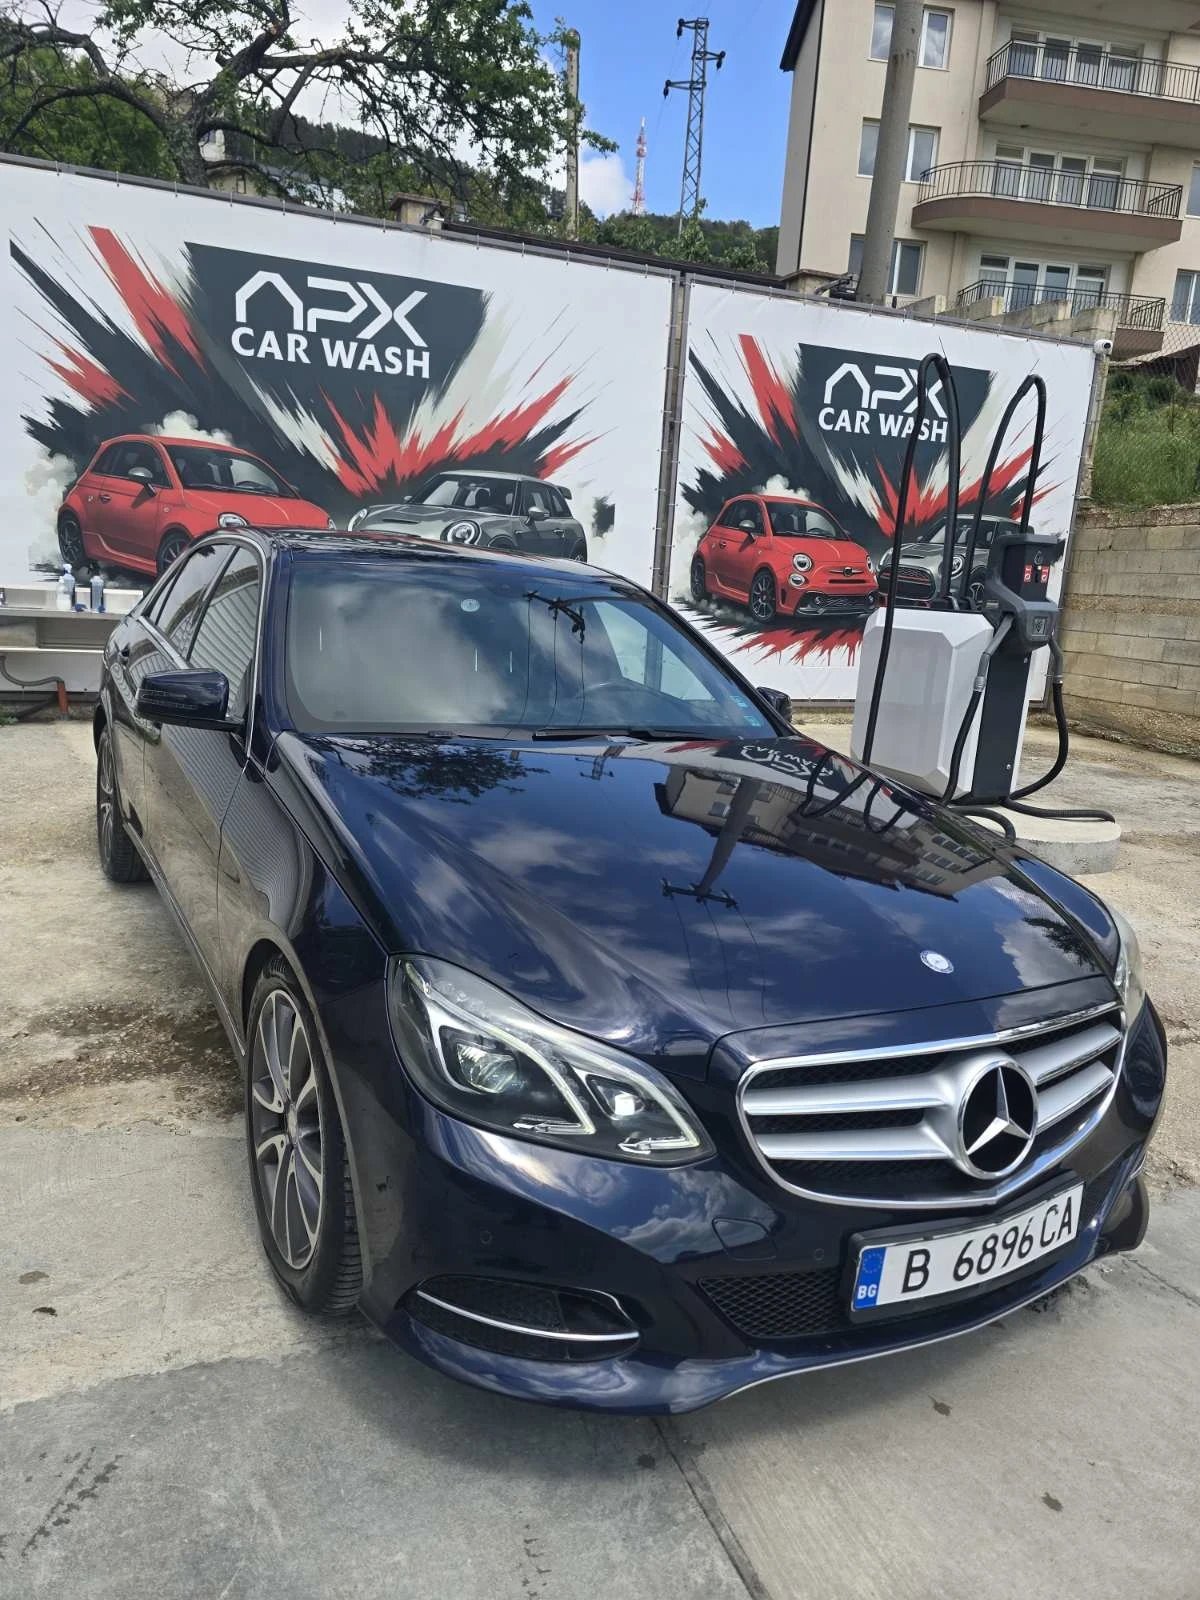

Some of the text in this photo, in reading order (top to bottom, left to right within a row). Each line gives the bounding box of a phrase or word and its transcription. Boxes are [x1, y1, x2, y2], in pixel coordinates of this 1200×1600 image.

[235, 270, 428, 347] APX
[231, 327, 430, 379] CAR WASH
[818, 407, 949, 443] CAR WASH
[901, 1196, 1072, 1294] B 6896 CA
[857, 1284, 877, 1300] BG
